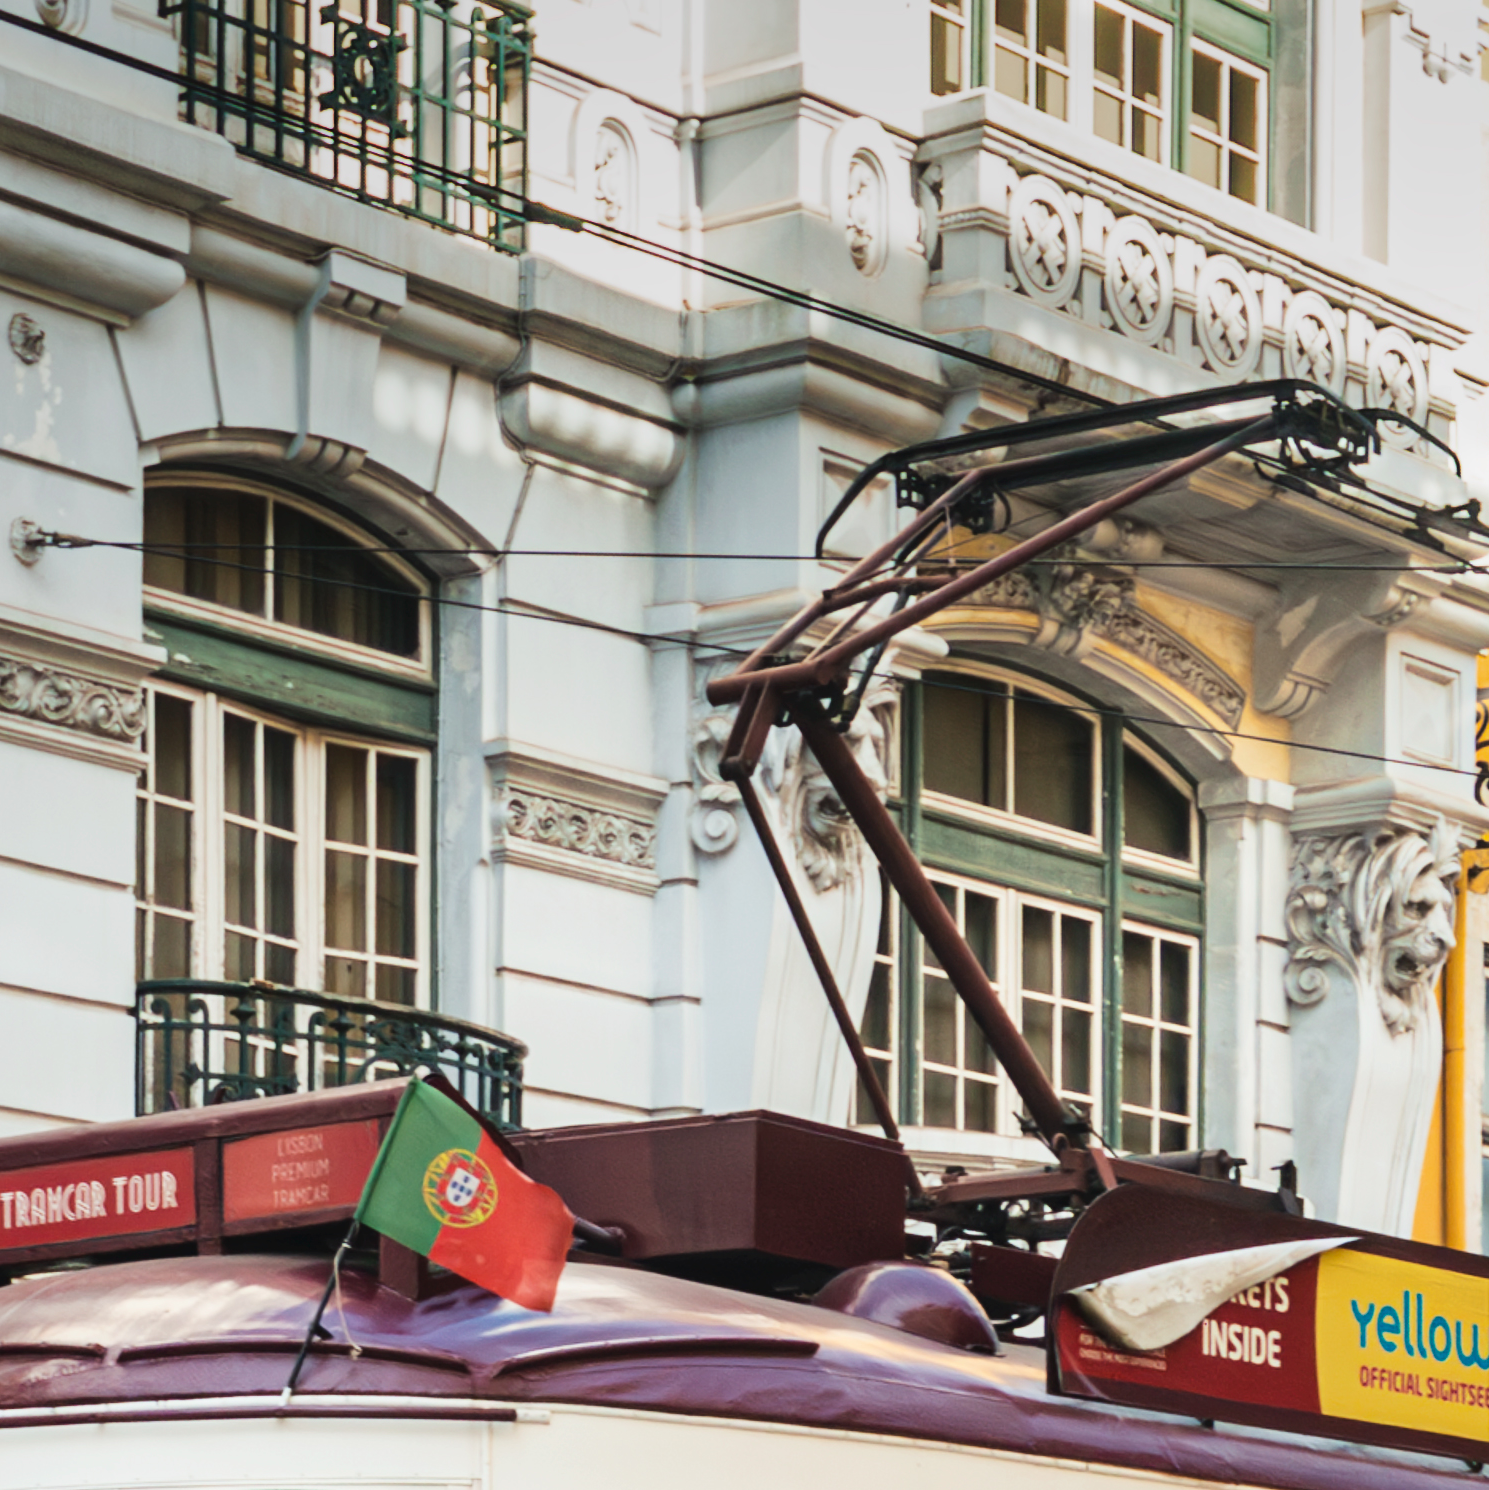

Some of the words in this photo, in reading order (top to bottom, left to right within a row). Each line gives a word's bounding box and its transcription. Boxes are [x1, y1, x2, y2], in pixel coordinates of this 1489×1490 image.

[277, 1133, 324, 1157] LISBON
[271, 1158, 330, 1182] PREMIUM
[0, 1180, 107, 1230] TRAMCAR
[112, 1170, 179, 1215] TOUR
[273, 1183, 330, 1208] TRAMCAR
[1202, 1318, 1282, 1368] INSIDE
[1359, 1365, 1424, 1397] OFFICIAL
